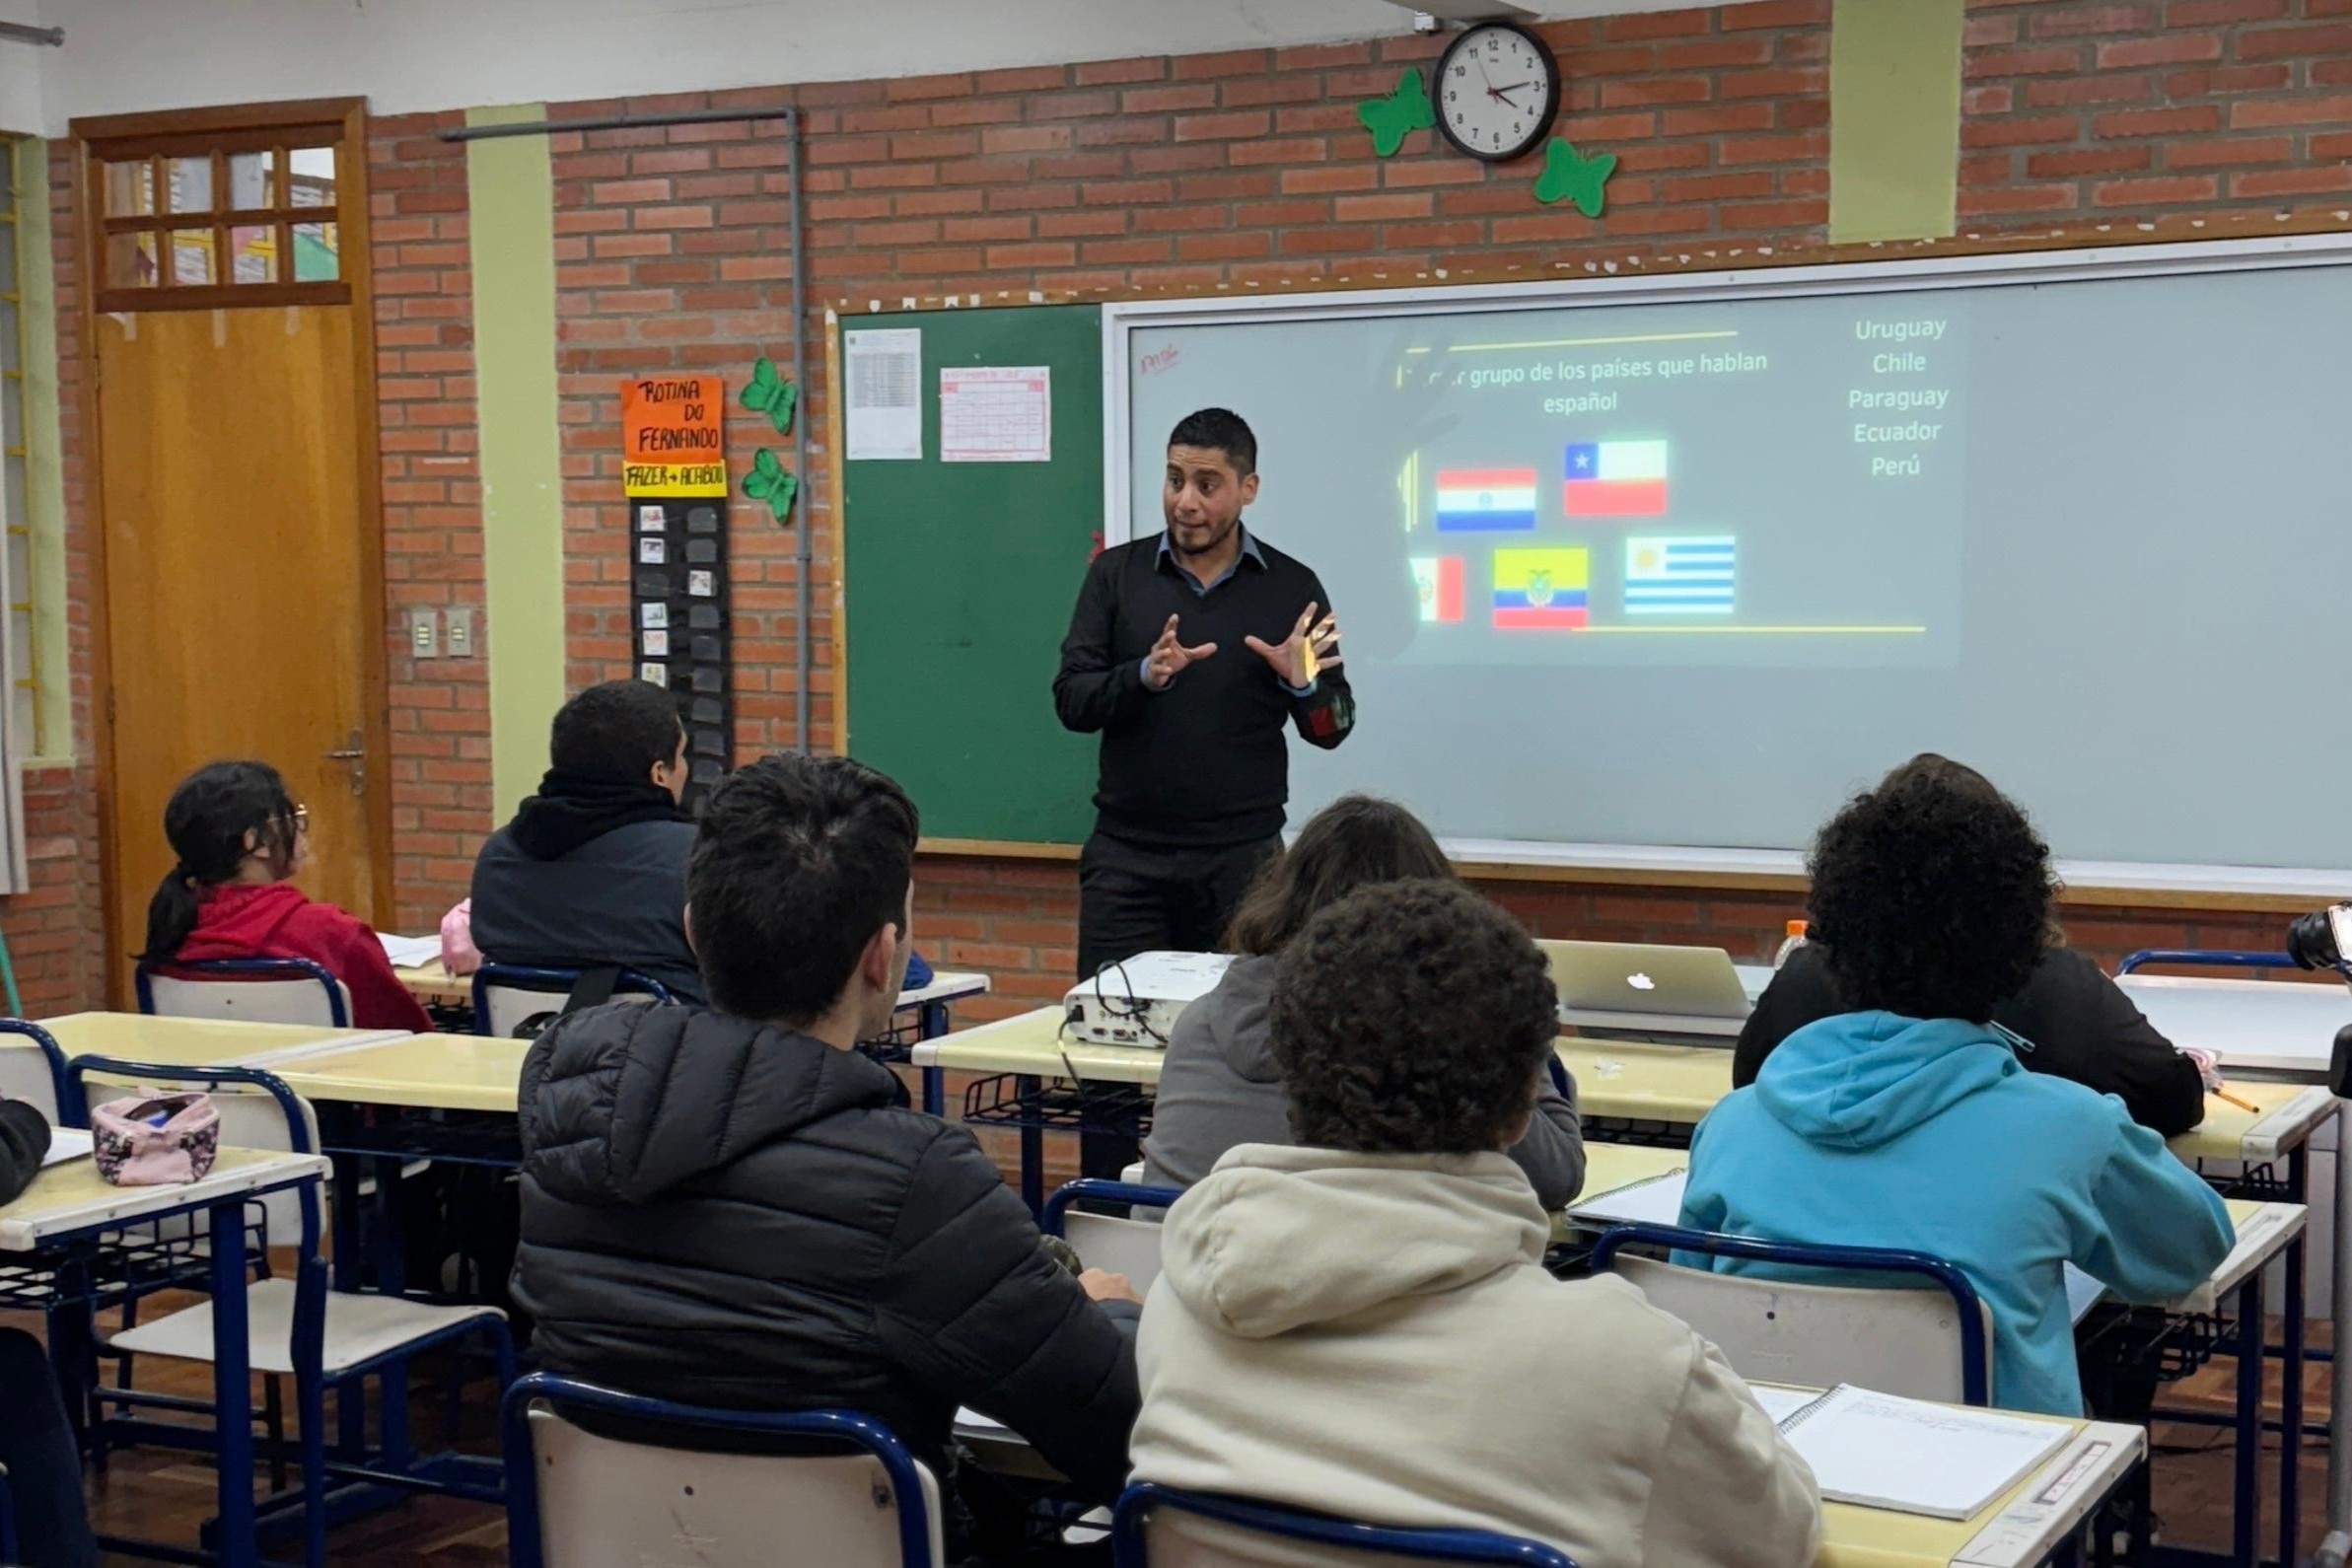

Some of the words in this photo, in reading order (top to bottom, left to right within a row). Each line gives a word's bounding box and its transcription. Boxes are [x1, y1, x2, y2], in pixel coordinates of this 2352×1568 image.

[1487, 39, 1499, 51] 12
[1511, 42, 1517, 53] 1
[1468, 48, 1478, 59] 11
[1527, 57, 1533, 69] 2
[1455, 65, 1465, 77] 10
[1533, 81, 1540, 92] 3
[1450, 91, 1457, 102] 9
[1528, 105, 1533, 116] 4
[1457, 112, 1463, 124] 8
[1471, 127, 1478, 139] 7
[1514, 122, 1521, 134] 5
[1493, 132, 1500, 144] 6
[1856, 320, 1947, 342] Uruguay
[1873, 351, 1926, 373] Chile
[1470, 366, 1526, 389] grupo
[1530, 362, 1553, 381] de
[1558, 360, 1586, 380] los
[1591, 357, 1653, 383] países
[1657, 358, 1694, 379] que
[1700, 352, 1767, 373] hablan
[638, 380, 700, 403] ROTINA
[1543, 392, 1617, 415] español
[1849, 390, 1949, 411] Paraguay
[684, 403, 704, 421] DO
[1854, 421, 1942, 443] Ecuador
[638, 427, 719, 453] FERNANDO
[1872, 453, 1920, 475] Perú
[625, 465, 668, 486] FAZER
